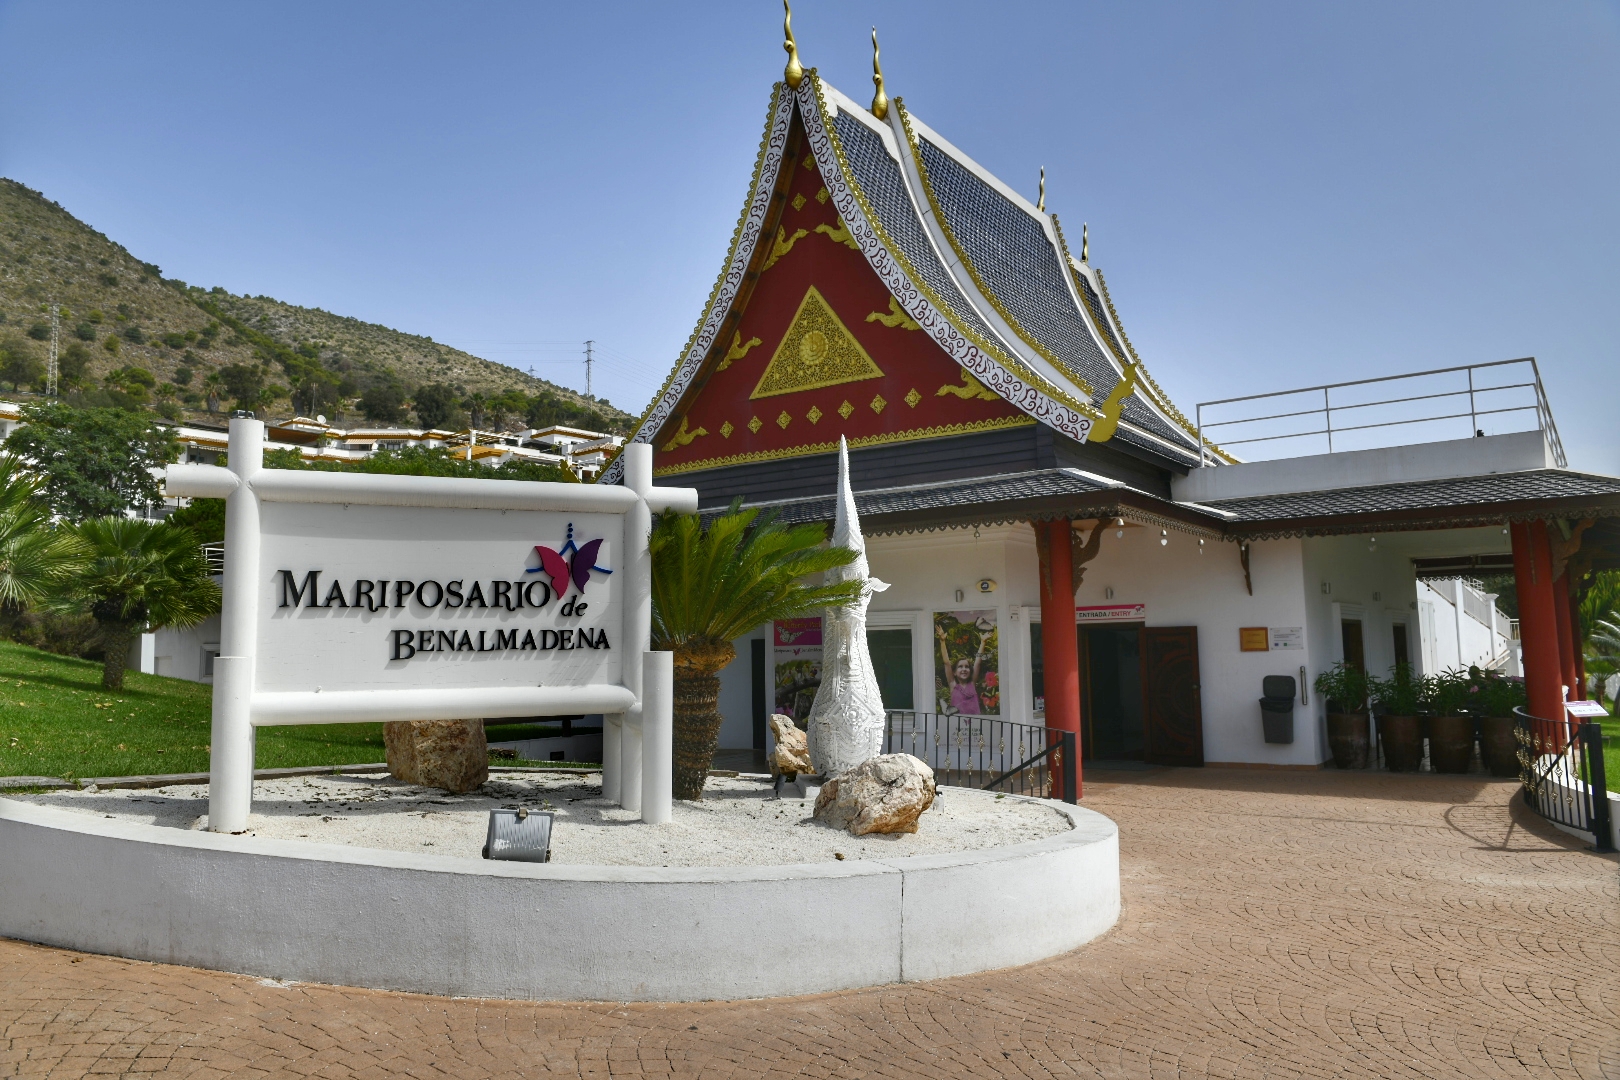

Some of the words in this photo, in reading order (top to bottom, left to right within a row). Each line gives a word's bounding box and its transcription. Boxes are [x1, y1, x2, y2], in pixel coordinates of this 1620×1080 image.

[277, 569, 551, 612] MARIPOSARIO
[560, 594, 588, 617] de
[389, 627, 611, 661] BENALMADENA
